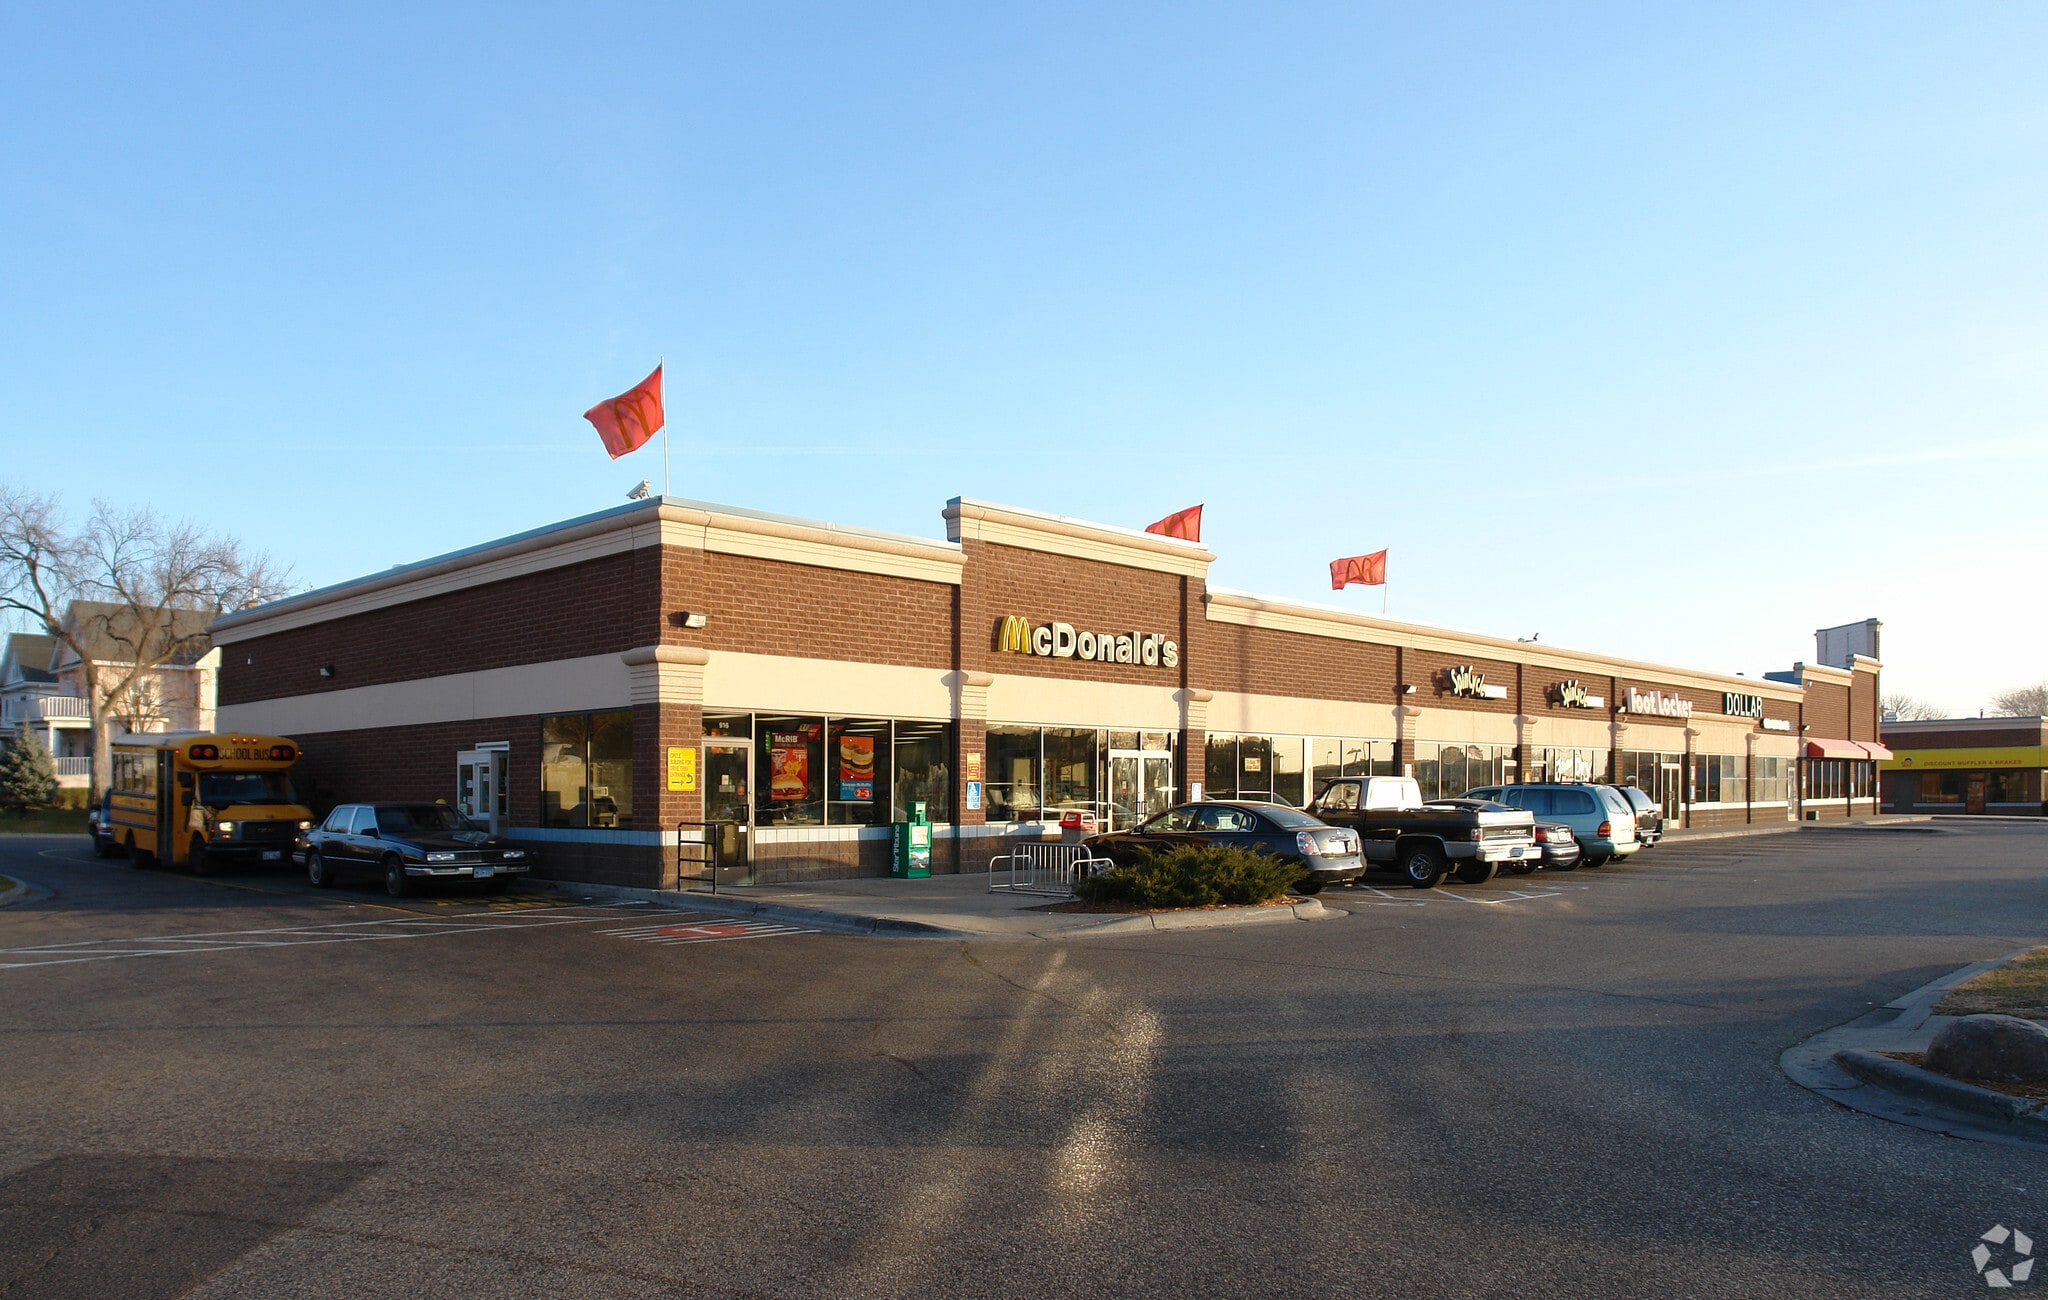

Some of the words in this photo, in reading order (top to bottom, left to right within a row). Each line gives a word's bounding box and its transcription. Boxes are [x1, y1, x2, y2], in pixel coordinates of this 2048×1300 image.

[999, 614, 1179, 668] McDonald's
[1656, 690, 1693, 718] Locker
[1725, 692, 1763, 718] DOLLAR
[774, 735, 799, 743] McRIB
[218, 748, 253, 760] SCHOOL
[253, 749, 270, 761] BUS
